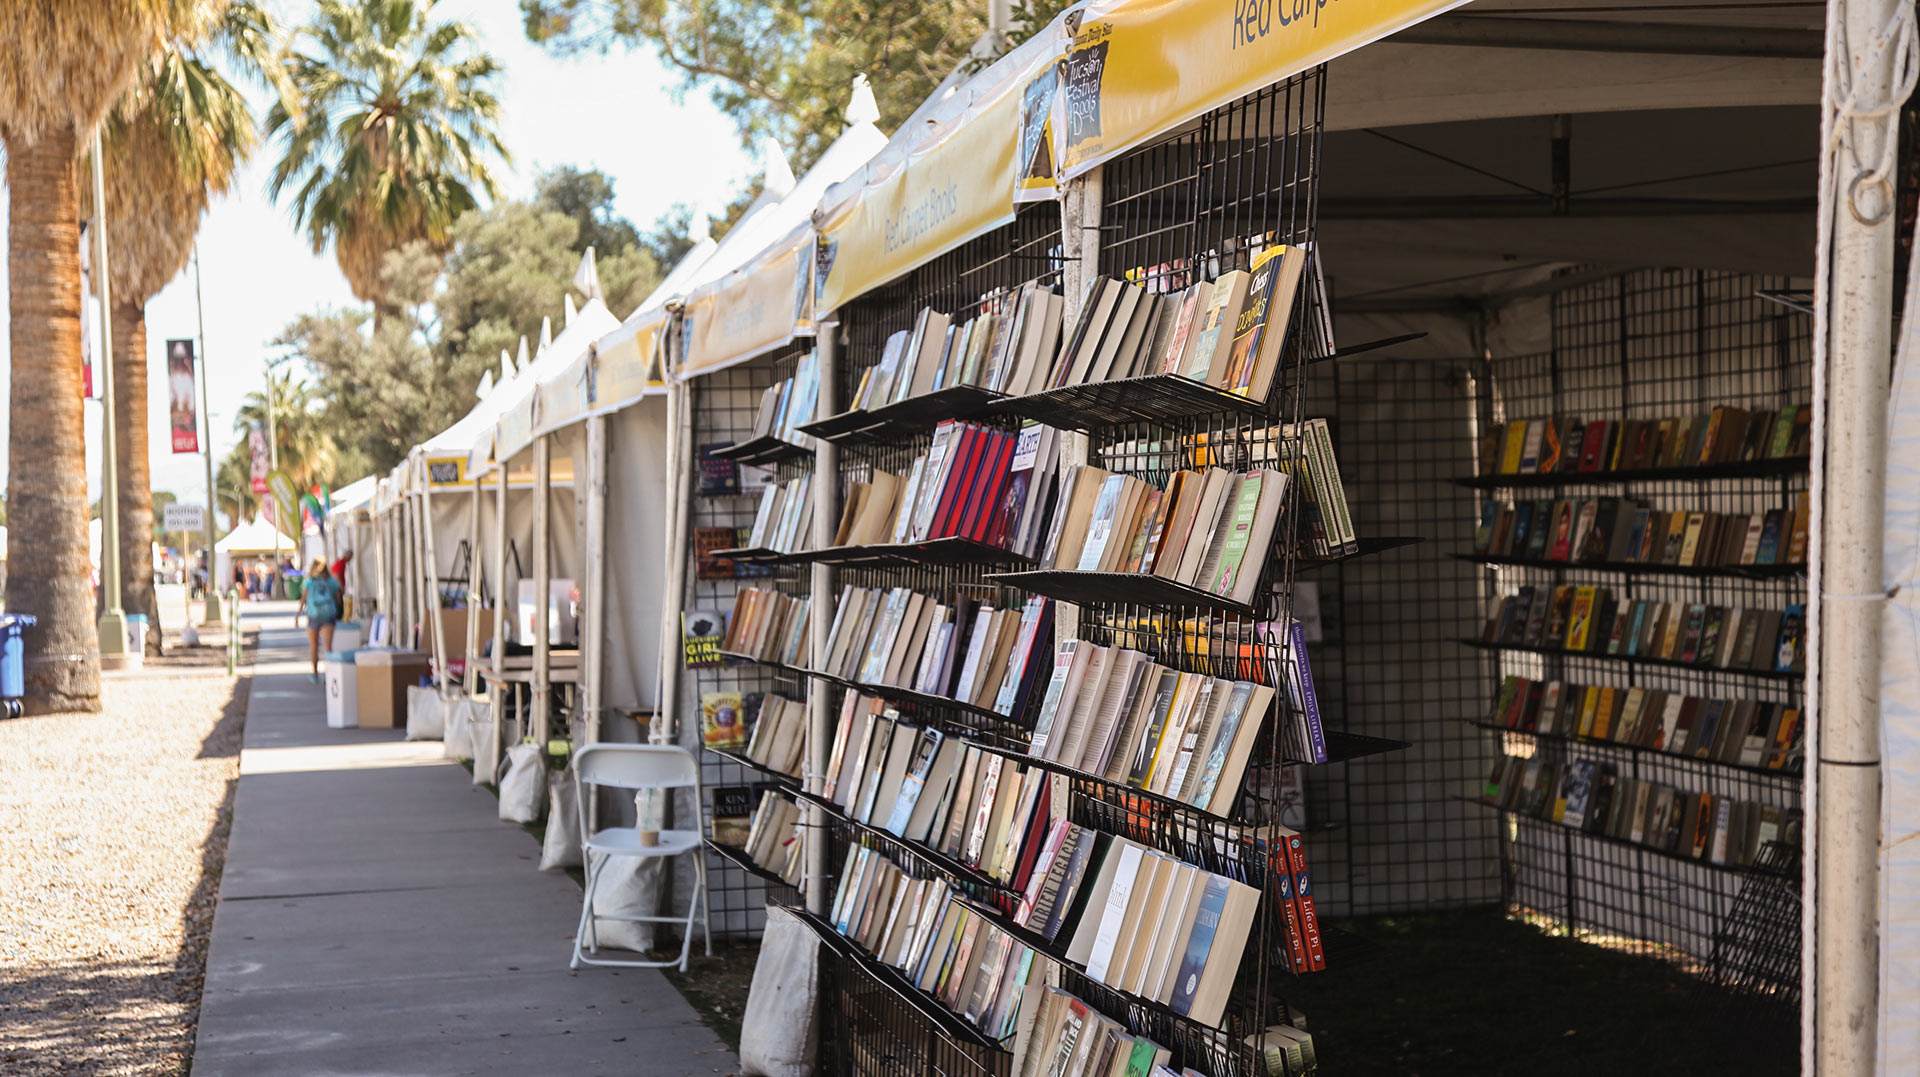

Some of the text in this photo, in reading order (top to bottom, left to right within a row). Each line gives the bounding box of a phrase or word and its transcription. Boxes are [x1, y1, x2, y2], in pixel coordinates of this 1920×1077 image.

[1233, 0, 1272, 50] Red
[1065, 62, 1103, 101] Festival
[1068, 57, 1101, 88] Tucson
[1072, 95, 1097, 136] Books
[884, 176, 958, 257] Red Carpet Books
[1250, 271, 1269, 296] Chess
[686, 643, 718, 656] GIRL
[687, 654, 721, 664] ALIVE
[1305, 691, 1314, 712] EMILY
[1309, 714, 1320, 742] LIEBERT
[725, 793, 745, 804] KEN
[1028, 827, 1080, 932] LORIEN LEGACIES
[1303, 900, 1320, 948] Life of Pi
[1292, 939, 1301, 951] Pi
